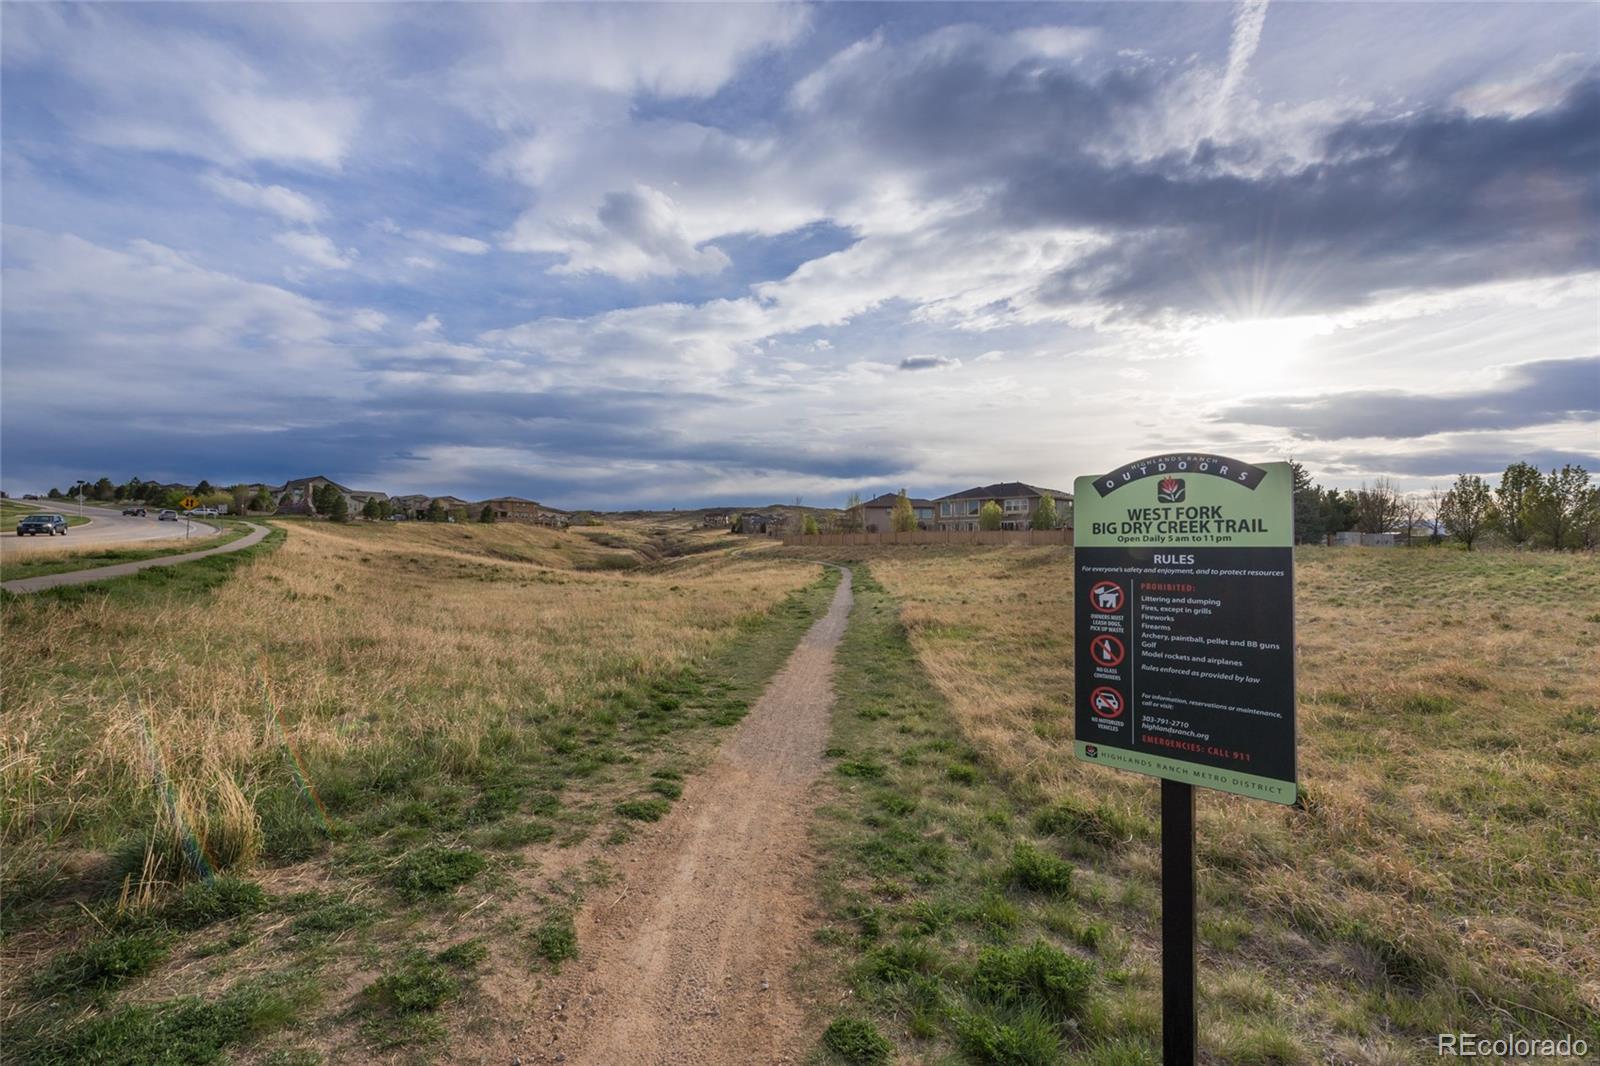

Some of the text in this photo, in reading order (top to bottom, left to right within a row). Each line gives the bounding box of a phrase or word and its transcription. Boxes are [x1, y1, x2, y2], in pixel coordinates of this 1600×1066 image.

[1131, 455, 1218, 470] HIGHLANDS RANCH
[1106, 462, 1248, 488] OUTDOORS
[1127, 506, 1222, 521] WEST FORK
[1092, 518, 1268, 535] BIG DRY CREEK TRAIL
[1117, 535, 1140, 543] Open
[1143, 535, 1165, 544] Daily
[1153, 554, 1194, 565] RULES
[1157, 567, 1194, 576] enjoyment,
[1219, 568, 1246, 577] protect
[1247, 569, 1285, 577] resources
[1141, 583, 1196, 592] PROHIBITED:
[1141, 595, 1171, 604] Littering
[1187, 598, 1221, 607] dumping
[1141, 604, 1159, 612] Fires,
[1160, 606, 1184, 614] except
[1193, 608, 1212, 616] grills
[1141, 613, 1174, 622] Fireworks
[1141, 622, 1171, 631] Firearms
[1141, 632, 1170, 641] Archery,
[1171, 635, 1205, 644] paintball,
[1206, 637, 1229, 646] pellet
[1247, 640, 1258, 648] BB
[1259, 642, 1280, 650] guns
[1164, 652, 1190, 661] rockets
[1207, 657, 1243, 667] airplanes
[1141, 663, 1159, 671] Rules
[1160, 666, 1190, 676] enforced
[1200, 671, 1233, 681] provided
[1234, 674, 1244, 683] by
[1245, 676, 1260, 684] law
[1152, 694, 1188, 704] information,
[1189, 700, 1227, 710] reservations
[1236, 706, 1283, 719] maintenance,
[1142, 715, 1189, 728] 303-791-2710
[1142, 722, 1209, 740] highlandsranch.org
[1141, 735, 1251, 761] EMERGENCIES: CALL 911
[1101, 752, 1283, 794] HIGHLANDS RANCH METRO DISTRICT
